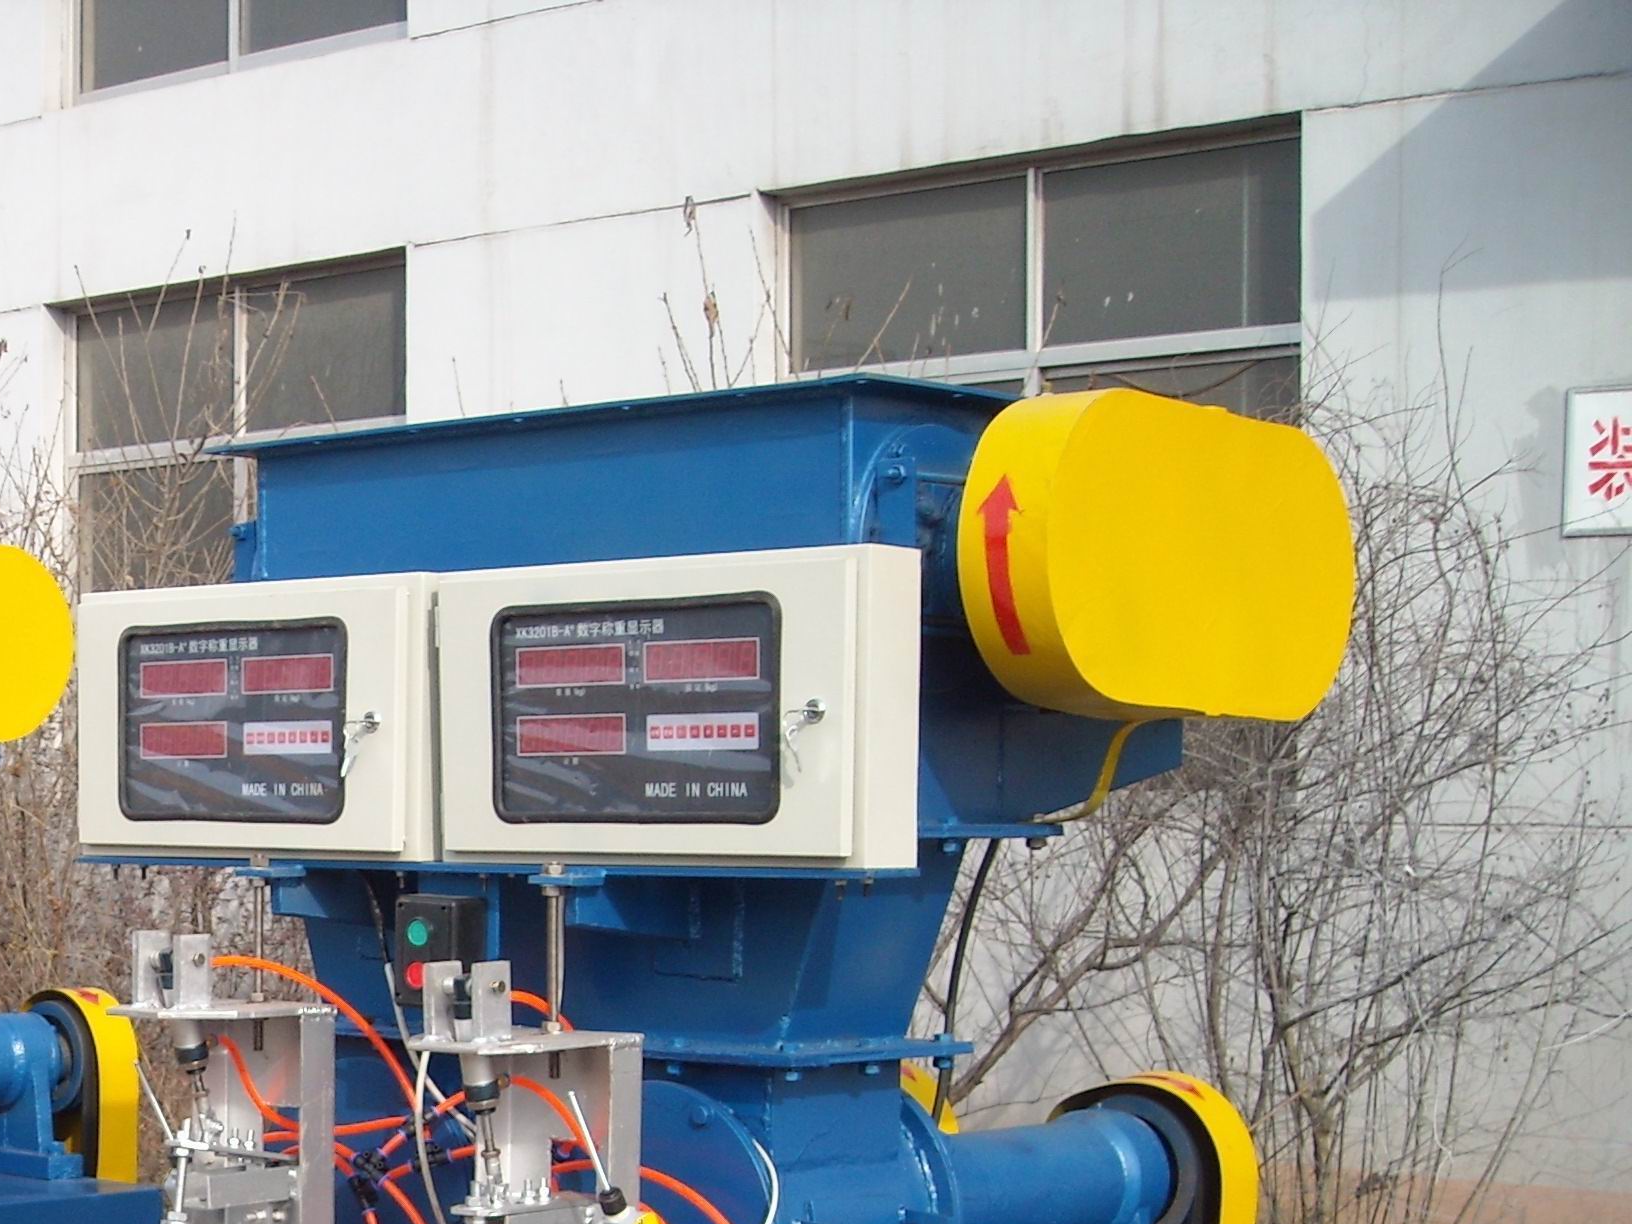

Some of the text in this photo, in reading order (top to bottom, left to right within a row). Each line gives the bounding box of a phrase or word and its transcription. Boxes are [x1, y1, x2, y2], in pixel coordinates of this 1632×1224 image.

[242, 782, 324, 797] MADE IN CHINA
[645, 782, 748, 798] MADE IN CHINA
